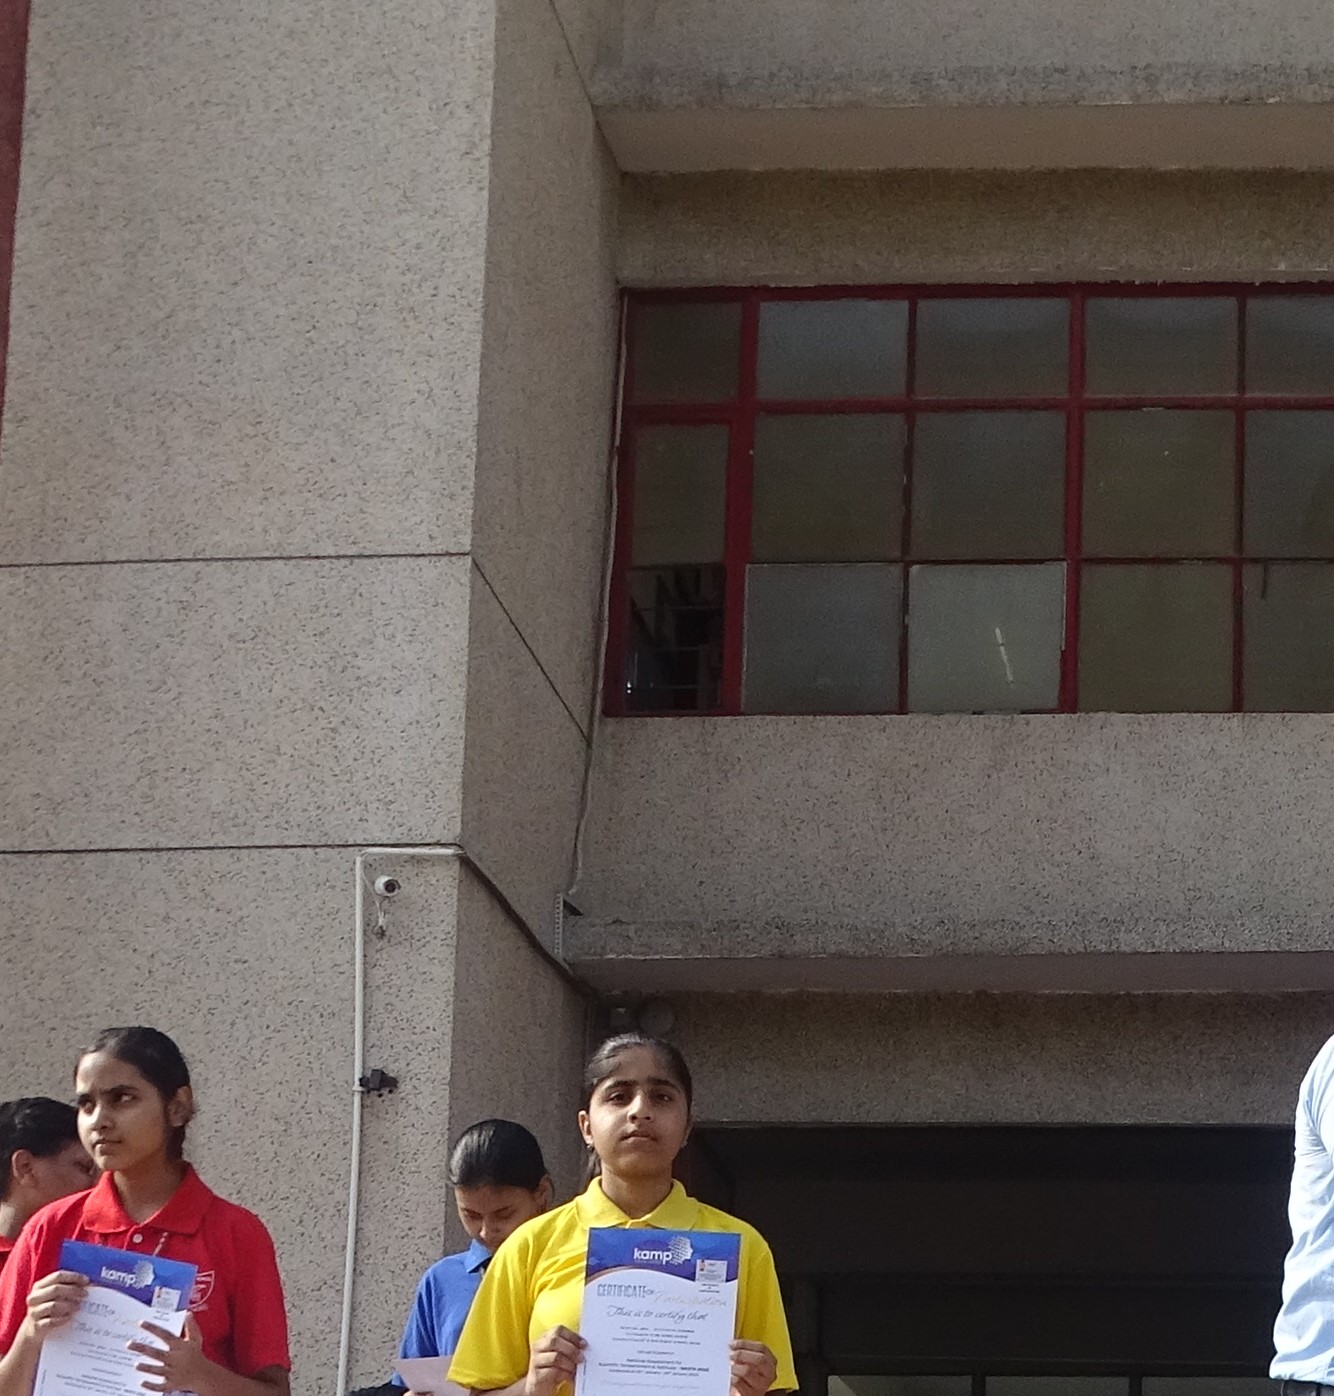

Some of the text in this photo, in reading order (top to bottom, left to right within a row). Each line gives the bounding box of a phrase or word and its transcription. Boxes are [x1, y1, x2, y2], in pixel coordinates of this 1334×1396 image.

[633, 1247, 673, 1265] kamp
[101, 1266, 136, 1287] kamp
[597, 1283, 647, 1298] CERTIFICATE
[607, 1305, 631, 1318] This
[655, 1309, 685, 1325] certify
[686, 1310, 708, 1321] that
